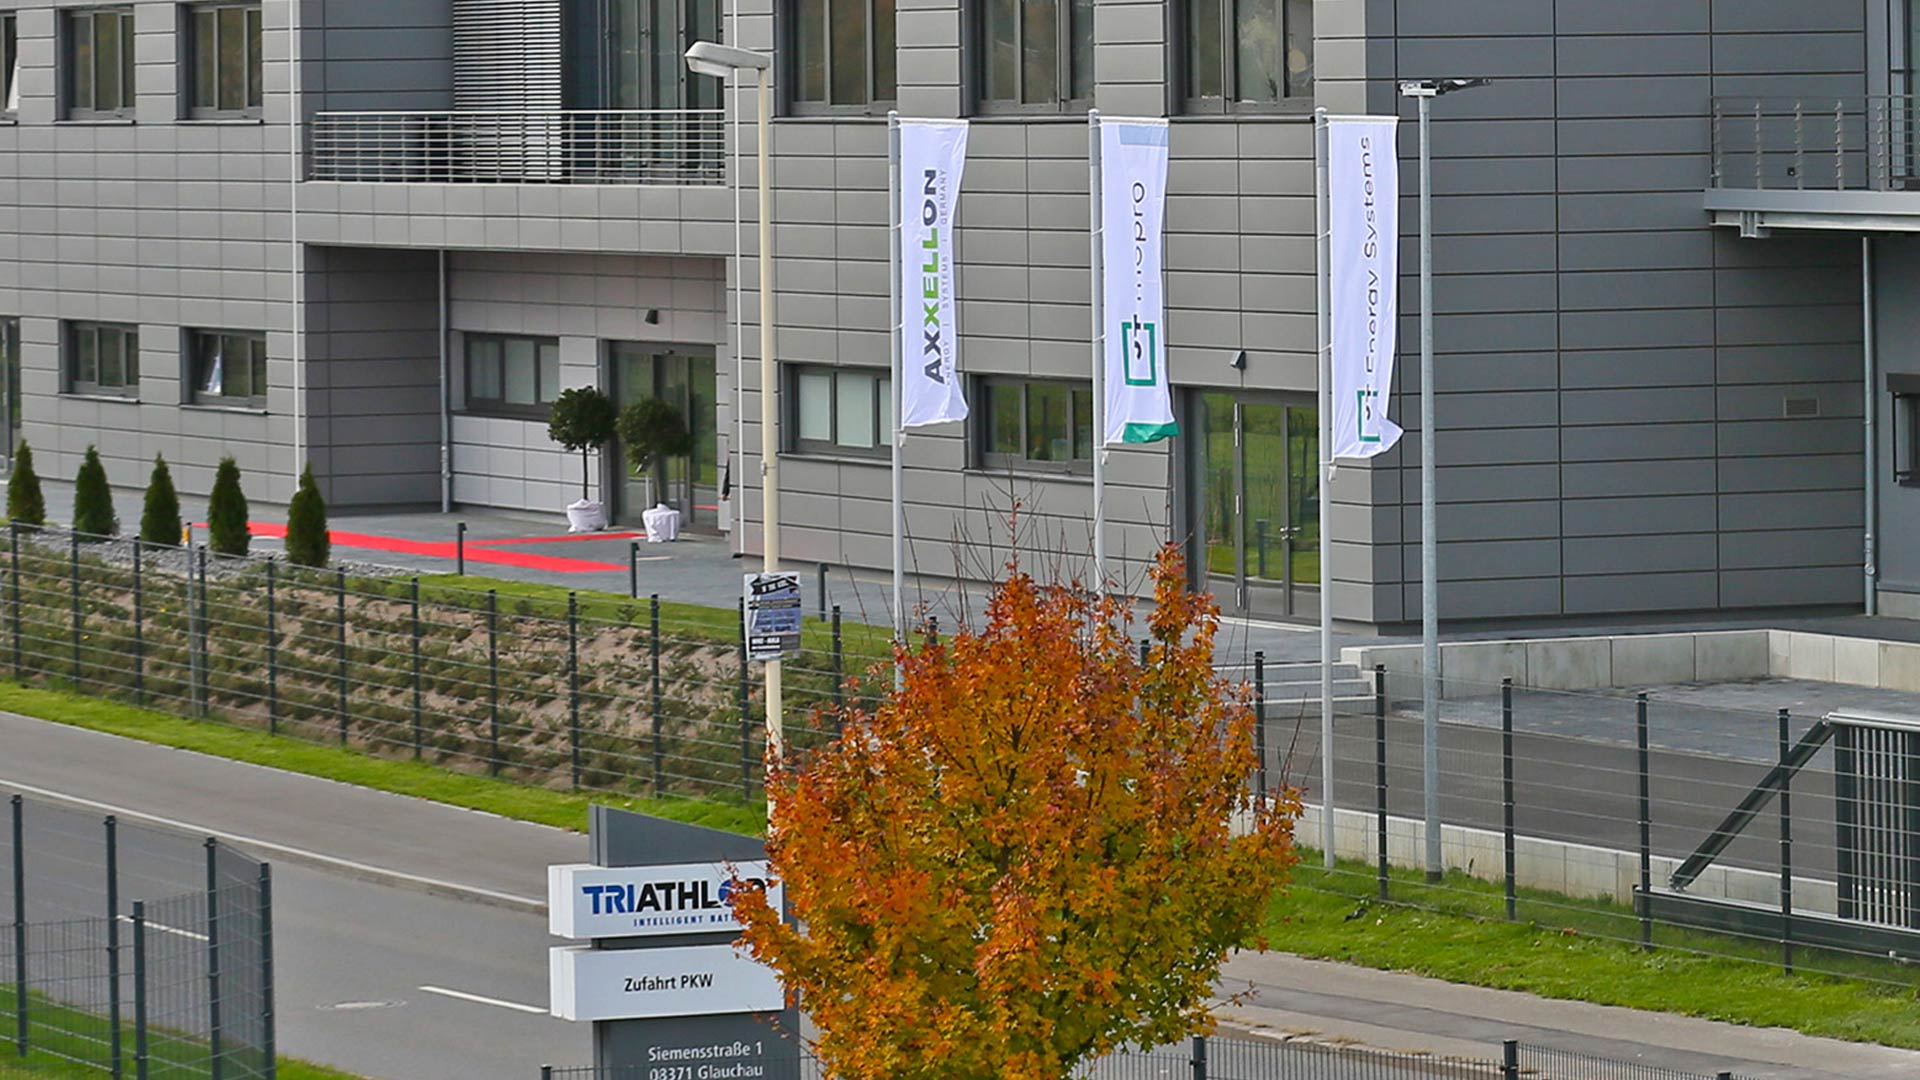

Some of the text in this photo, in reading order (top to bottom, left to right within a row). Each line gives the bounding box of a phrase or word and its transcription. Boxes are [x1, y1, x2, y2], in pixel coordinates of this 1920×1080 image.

[1359, 136, 1377, 260] Systems
[922, 169, 945, 385] AXXELLON
[939, 169, 951, 386] ENERGY SYSTEMS GERMANY
[634, 915, 703, 927] INTELLIGENT
[624, 973, 713, 992] Zufahrt PKW
[649, 1041, 762, 1061] Siemensstraße 1
[649, 1063, 764, 1080] 08371 Glauchau
